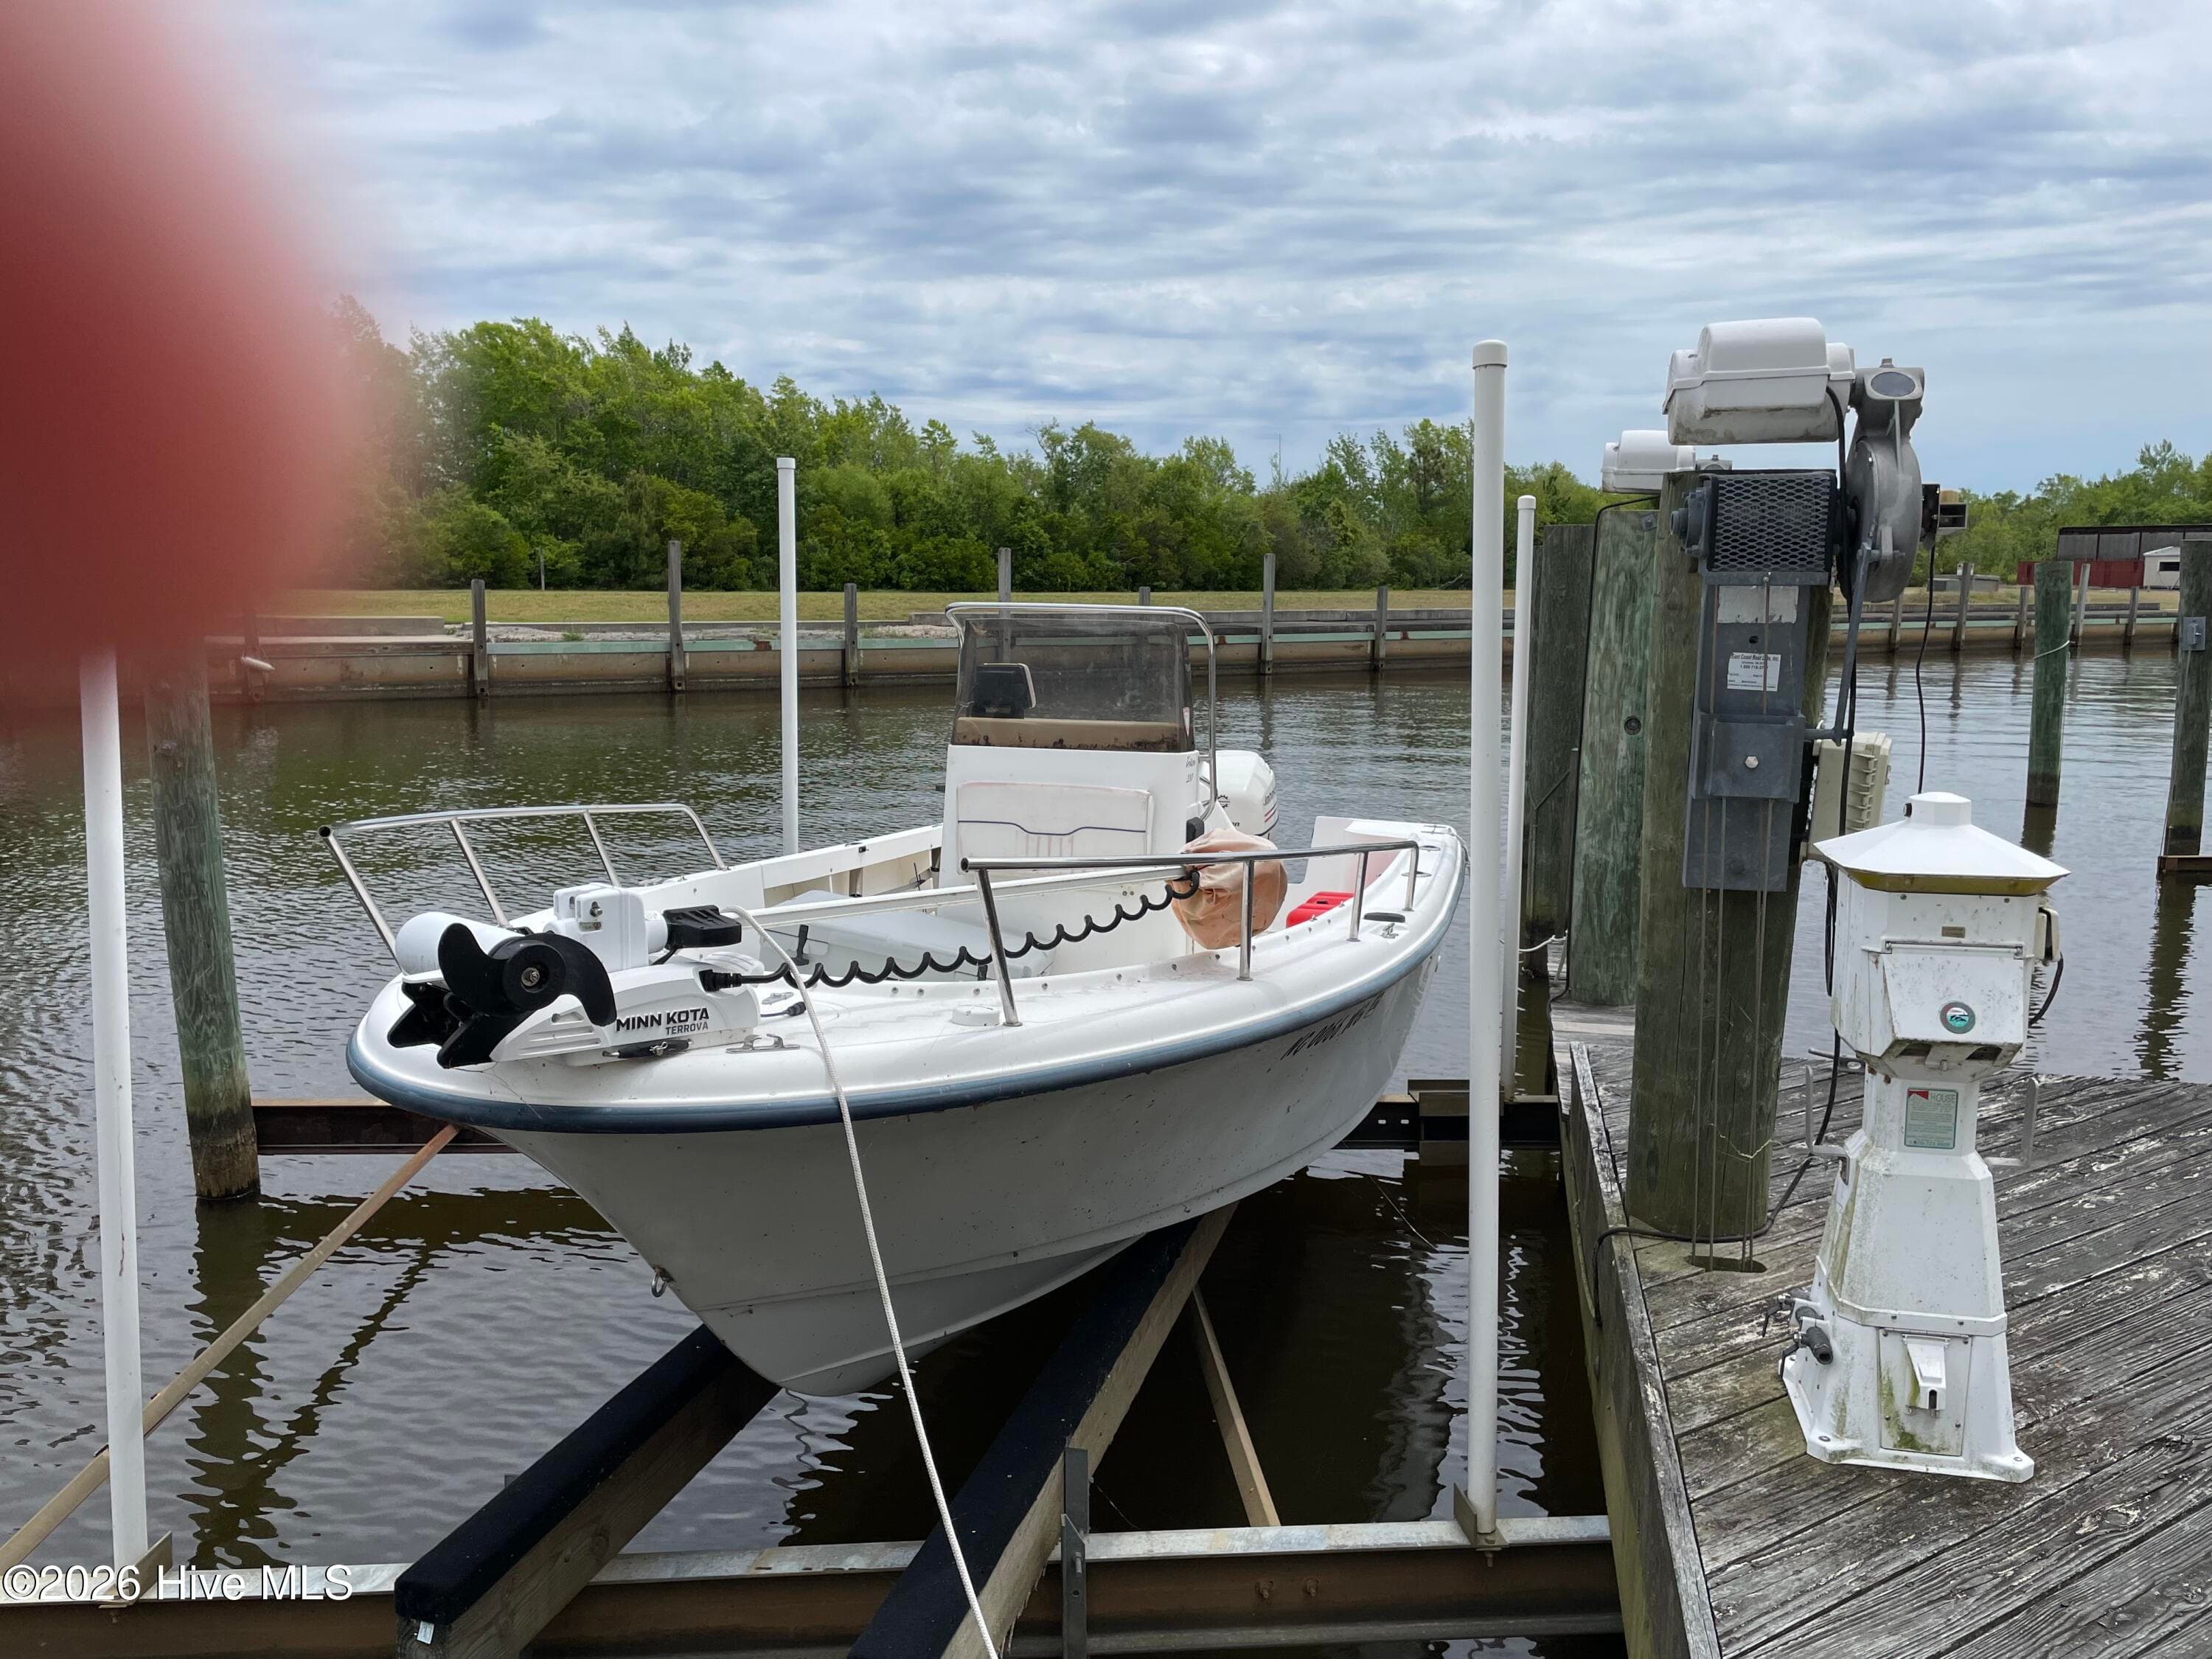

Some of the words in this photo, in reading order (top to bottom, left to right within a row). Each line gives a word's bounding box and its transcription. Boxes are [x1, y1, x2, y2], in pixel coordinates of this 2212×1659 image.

[616, 1013, 662, 1032] MINN
[666, 1007, 709, 1025] KOTA
[665, 1021, 708, 1035] TERROVA
[1930, 1093, 1956, 1104] HOUSE
